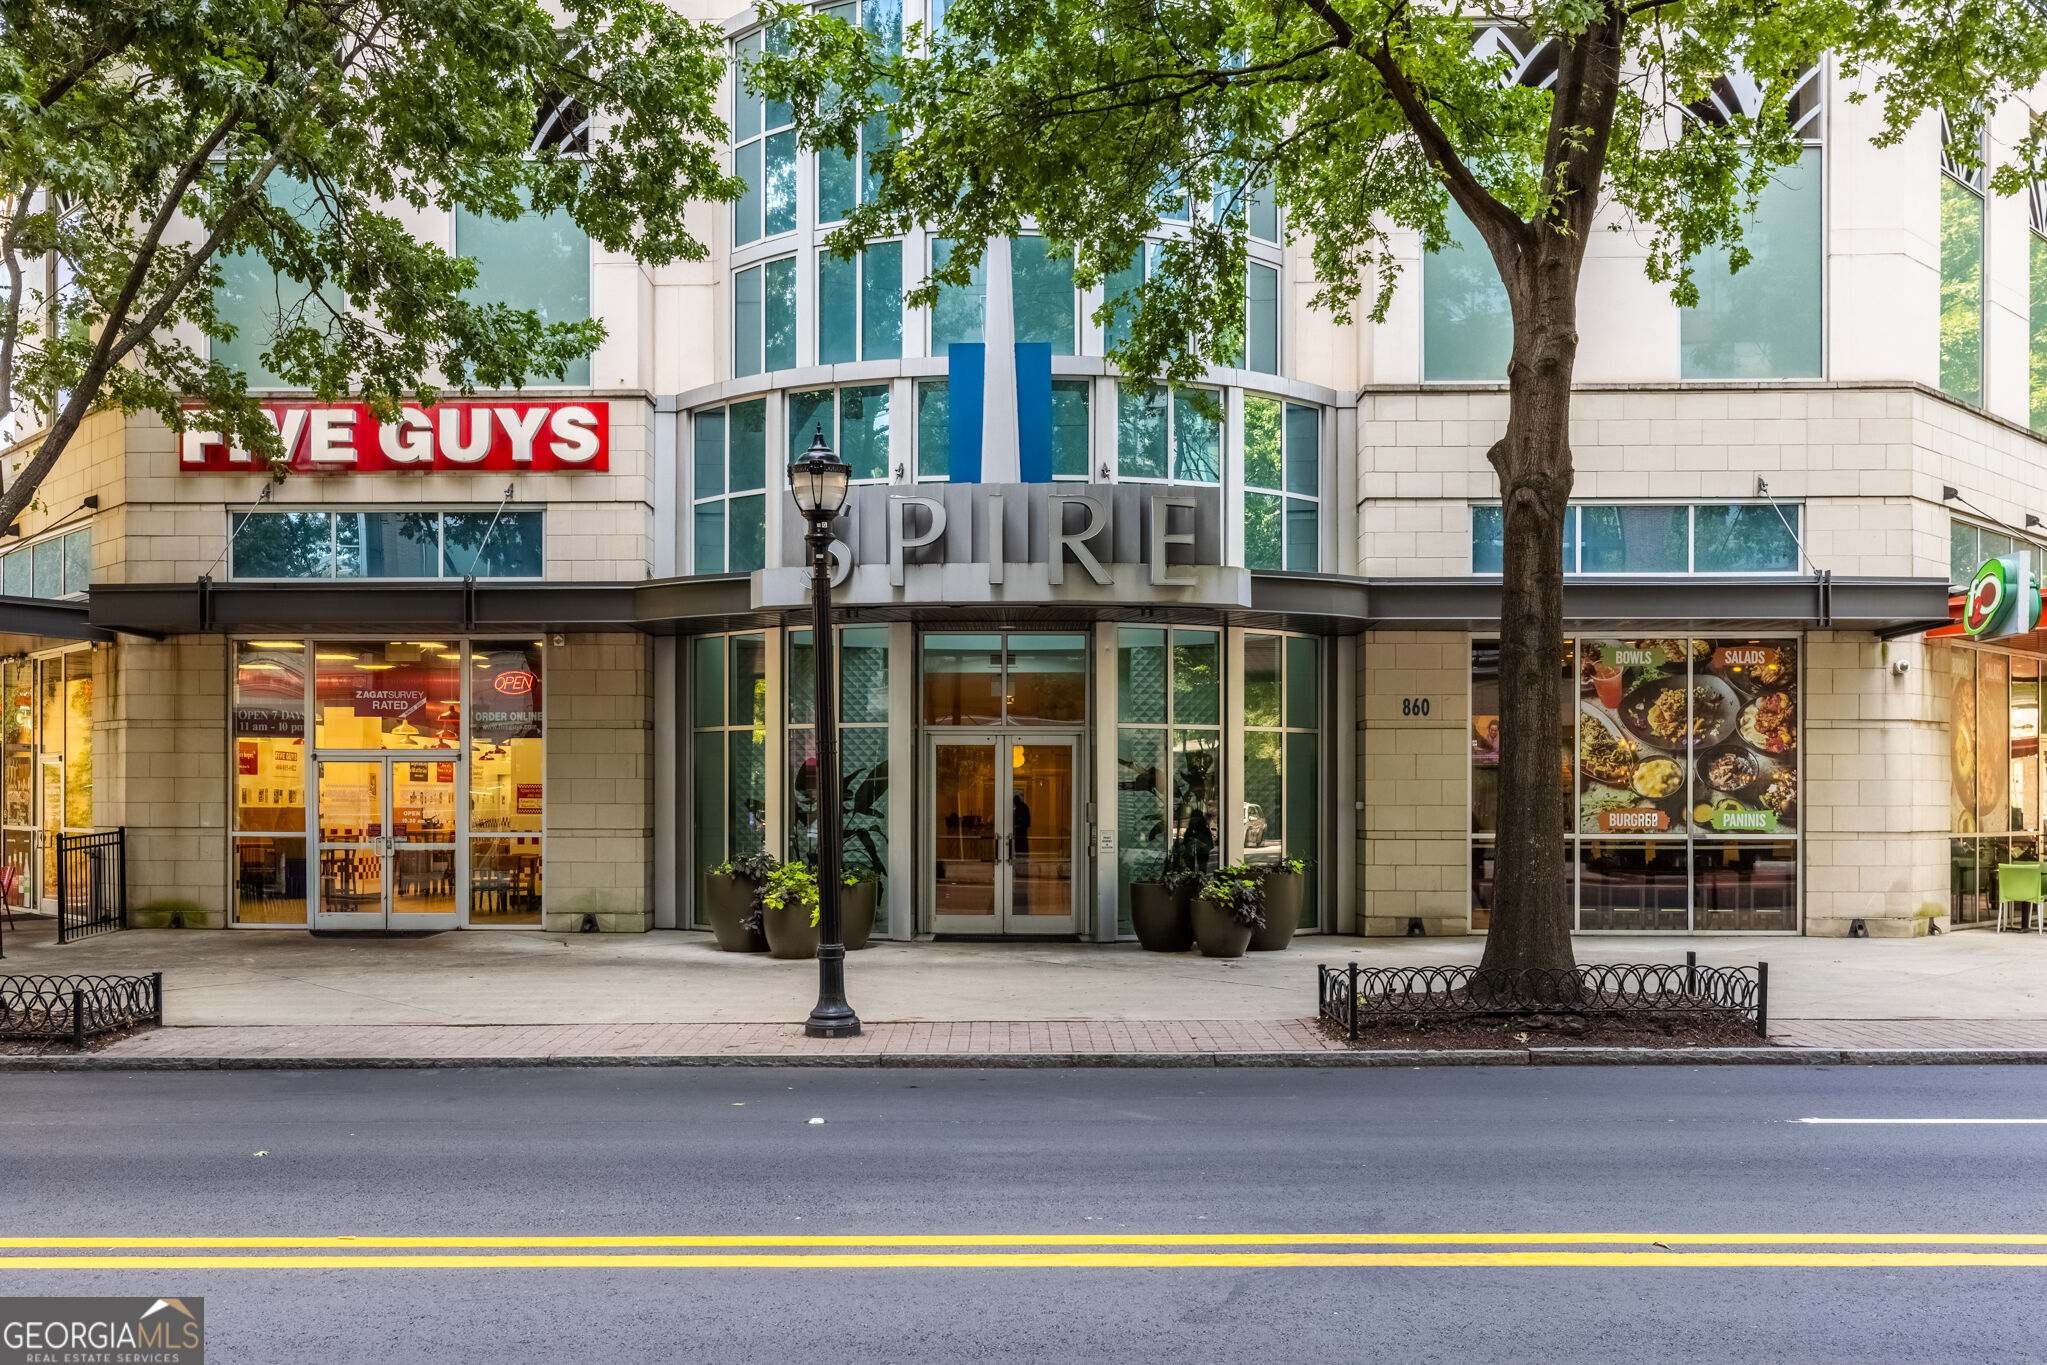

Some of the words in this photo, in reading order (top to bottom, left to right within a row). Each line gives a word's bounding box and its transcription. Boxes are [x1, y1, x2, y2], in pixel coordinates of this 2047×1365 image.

[379, 406, 600, 463] GUYS
[1615, 651, 1652, 664] BOWLS
[1725, 650, 1765, 664] SALADS
[494, 675, 533, 690] OPEN
[355, 690, 424, 699] ZAGATSURVEY
[372, 700, 409, 710] RATED
[1403, 698, 1430, 716] 860
[238, 710, 269, 720] OPEN
[271, 710, 278, 720] 7
[475, 711, 507, 721] ORDER
[509, 711, 542, 721] ONLINE
[240, 722, 249, 731] 11
[279, 722, 288, 731] 10
[1723, 813, 1766, 827] PANINIS
